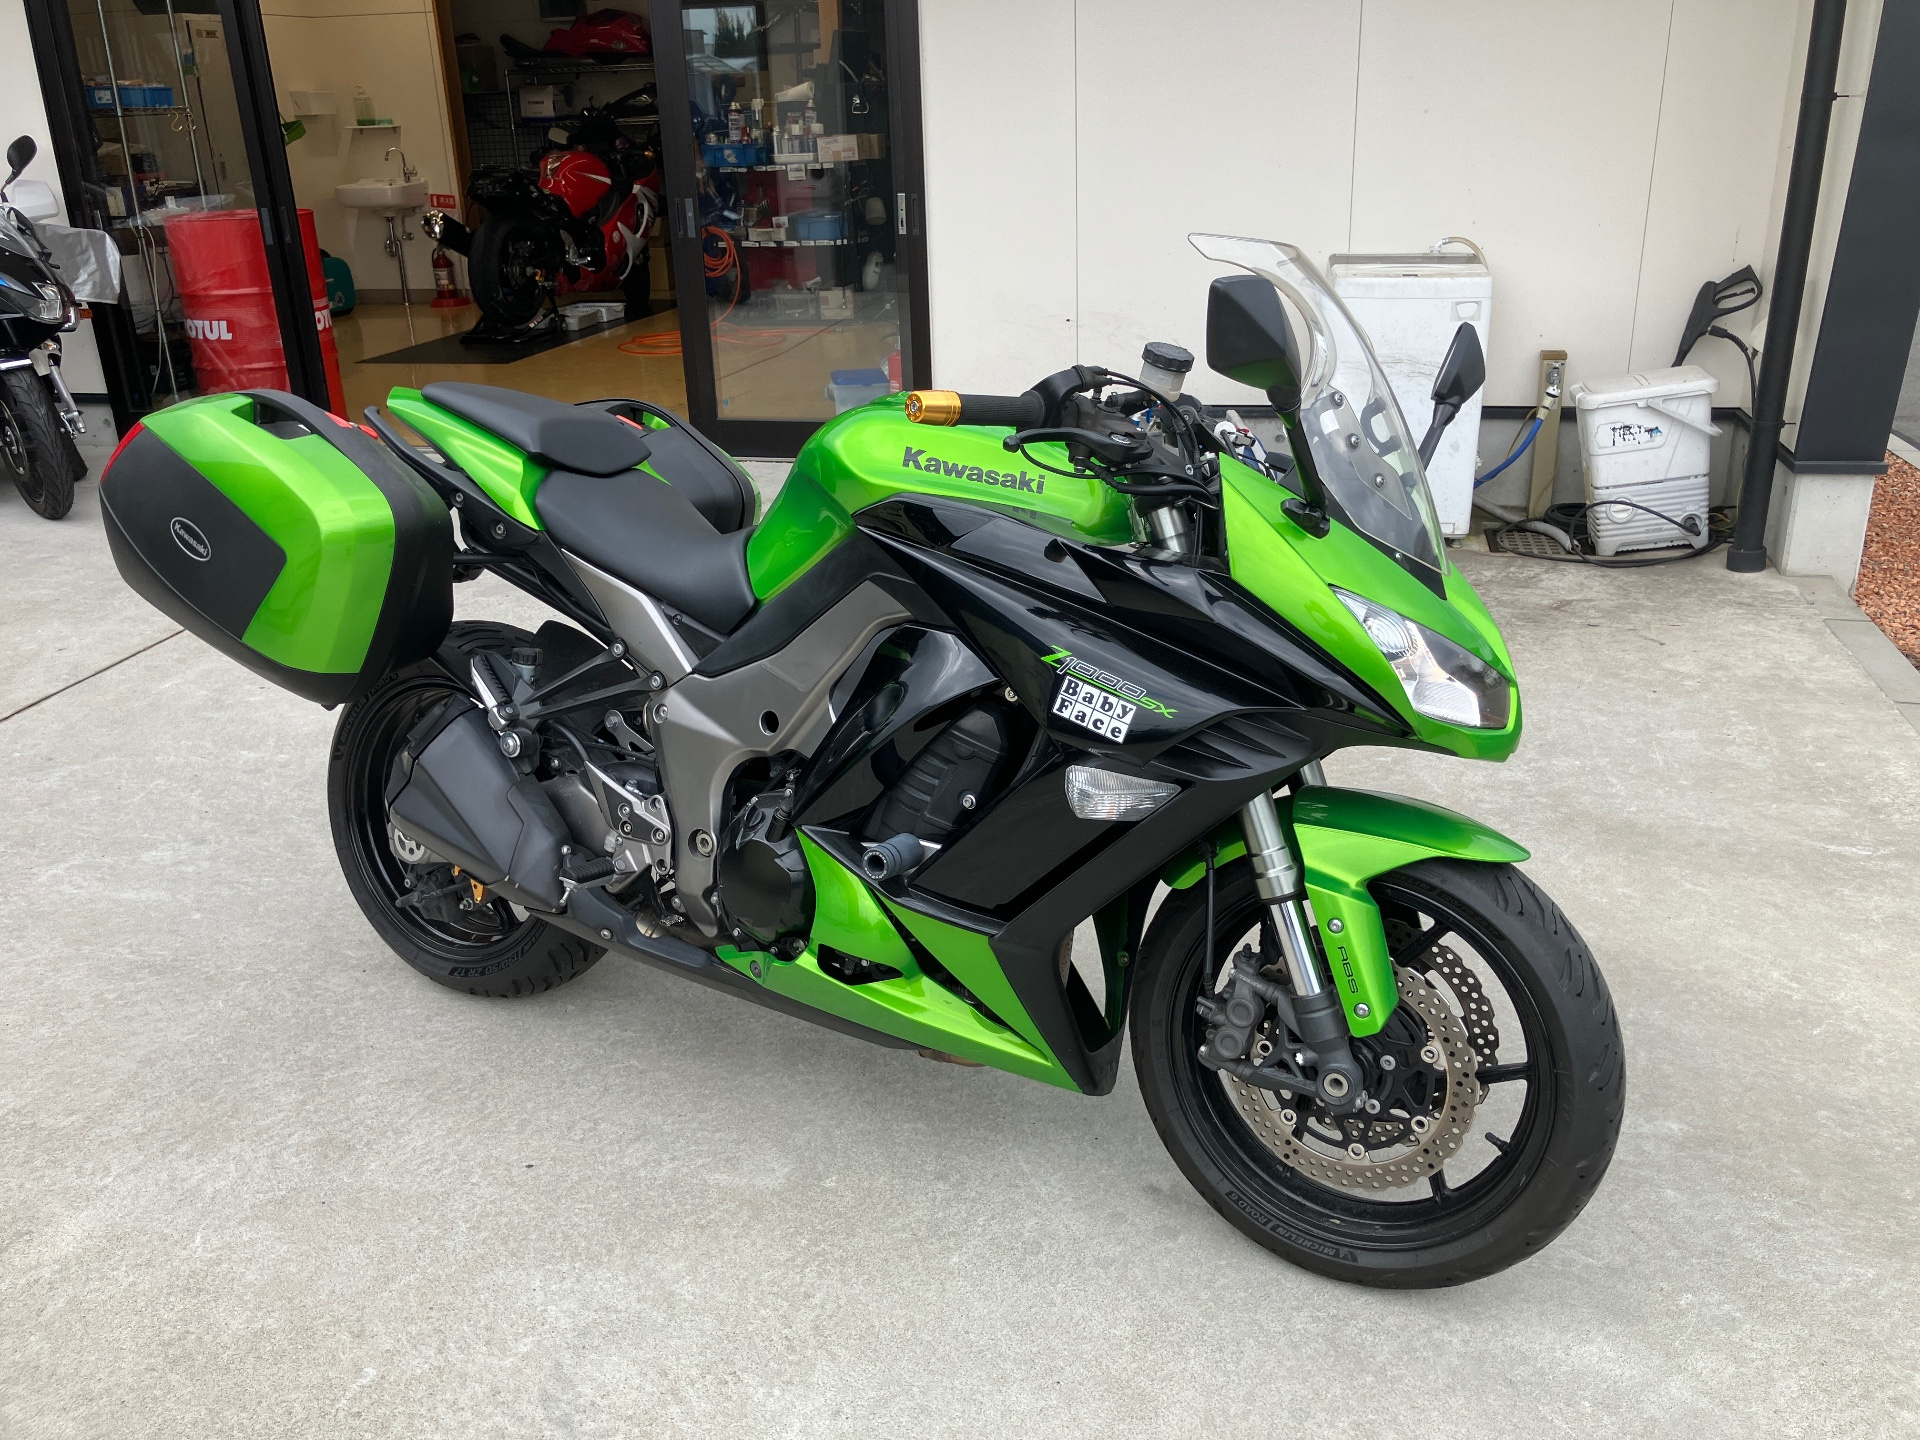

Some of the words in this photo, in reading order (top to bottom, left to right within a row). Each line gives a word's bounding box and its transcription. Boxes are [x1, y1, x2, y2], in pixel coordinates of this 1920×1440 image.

[185, 319, 233, 341] OTUL
[902, 446, 1046, 495] Kawasaki
[174, 521, 208, 557] Kawasaki
[1055, 697, 1122, 739] Face
[1062, 679, 1134, 719] Baby
[1337, 945, 1359, 994] ABS
[1237, 1199, 1270, 1224] ROAD
[1275, 1226, 1338, 1257] MICHELIN
